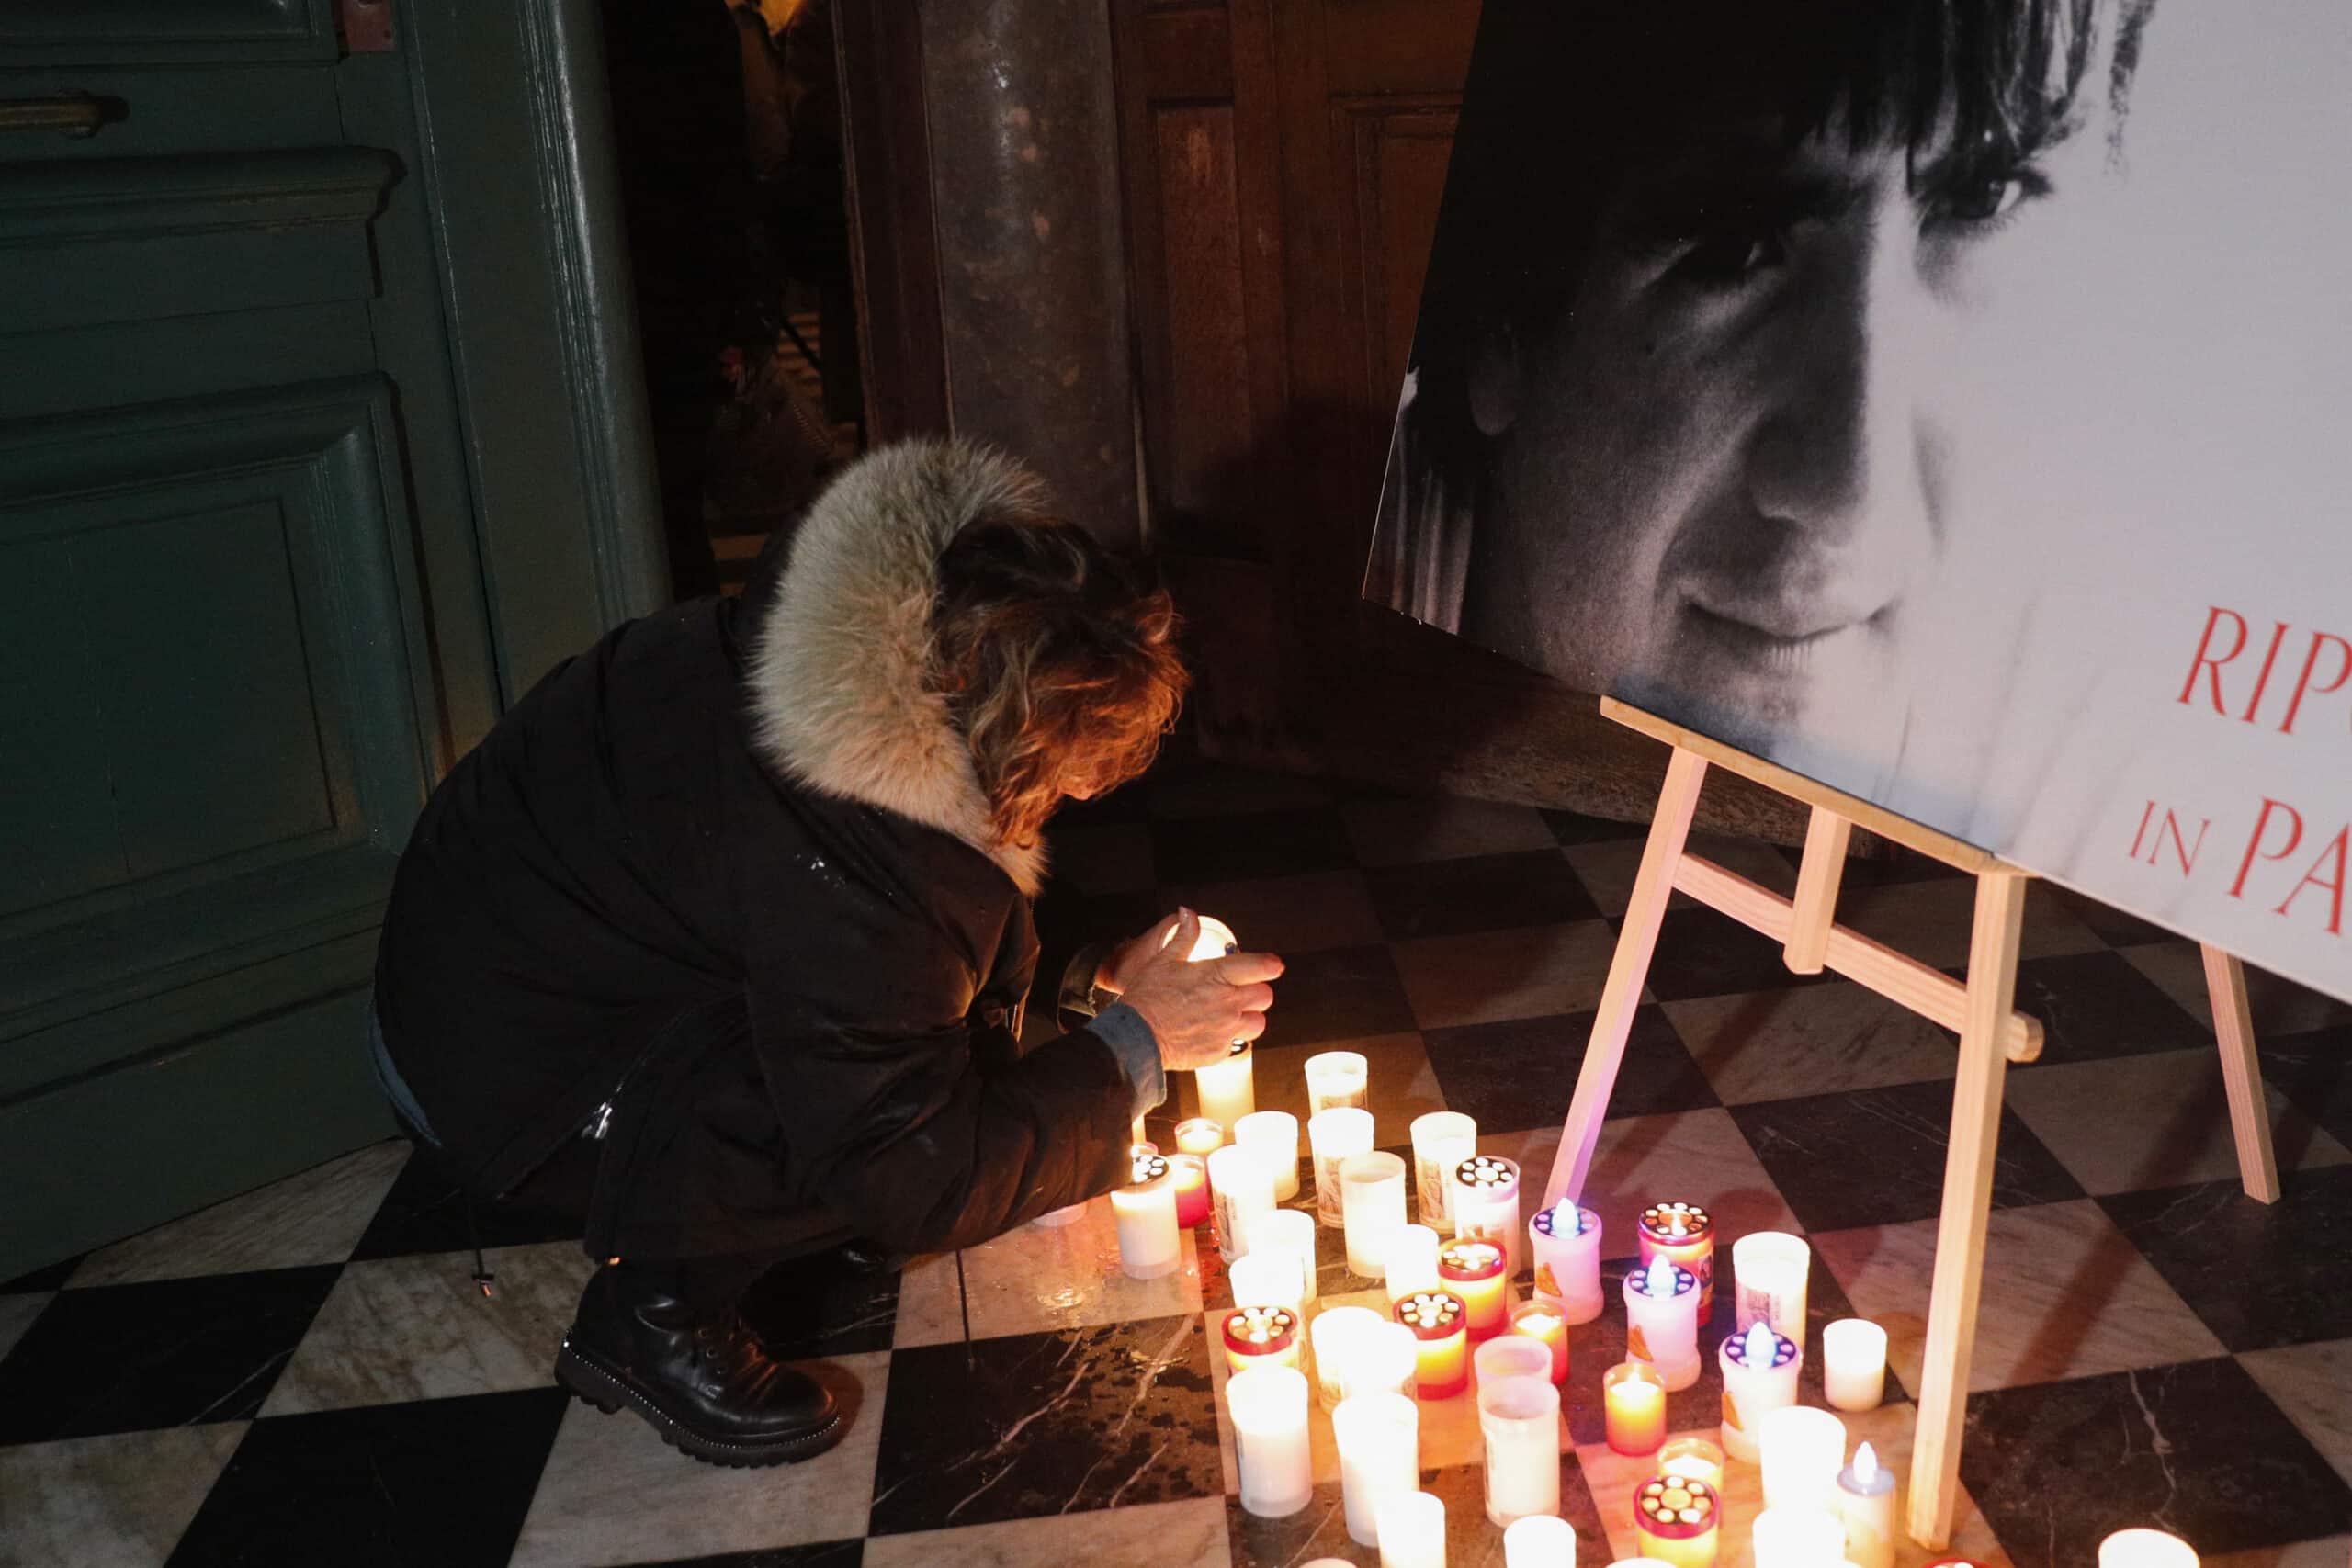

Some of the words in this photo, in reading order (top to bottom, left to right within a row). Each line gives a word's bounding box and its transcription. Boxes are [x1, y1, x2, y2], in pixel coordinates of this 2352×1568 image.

[2177, 605, 2352, 735] RIP
[2129, 799, 2211, 878] IN
[2228, 795, 2350, 937] PA
